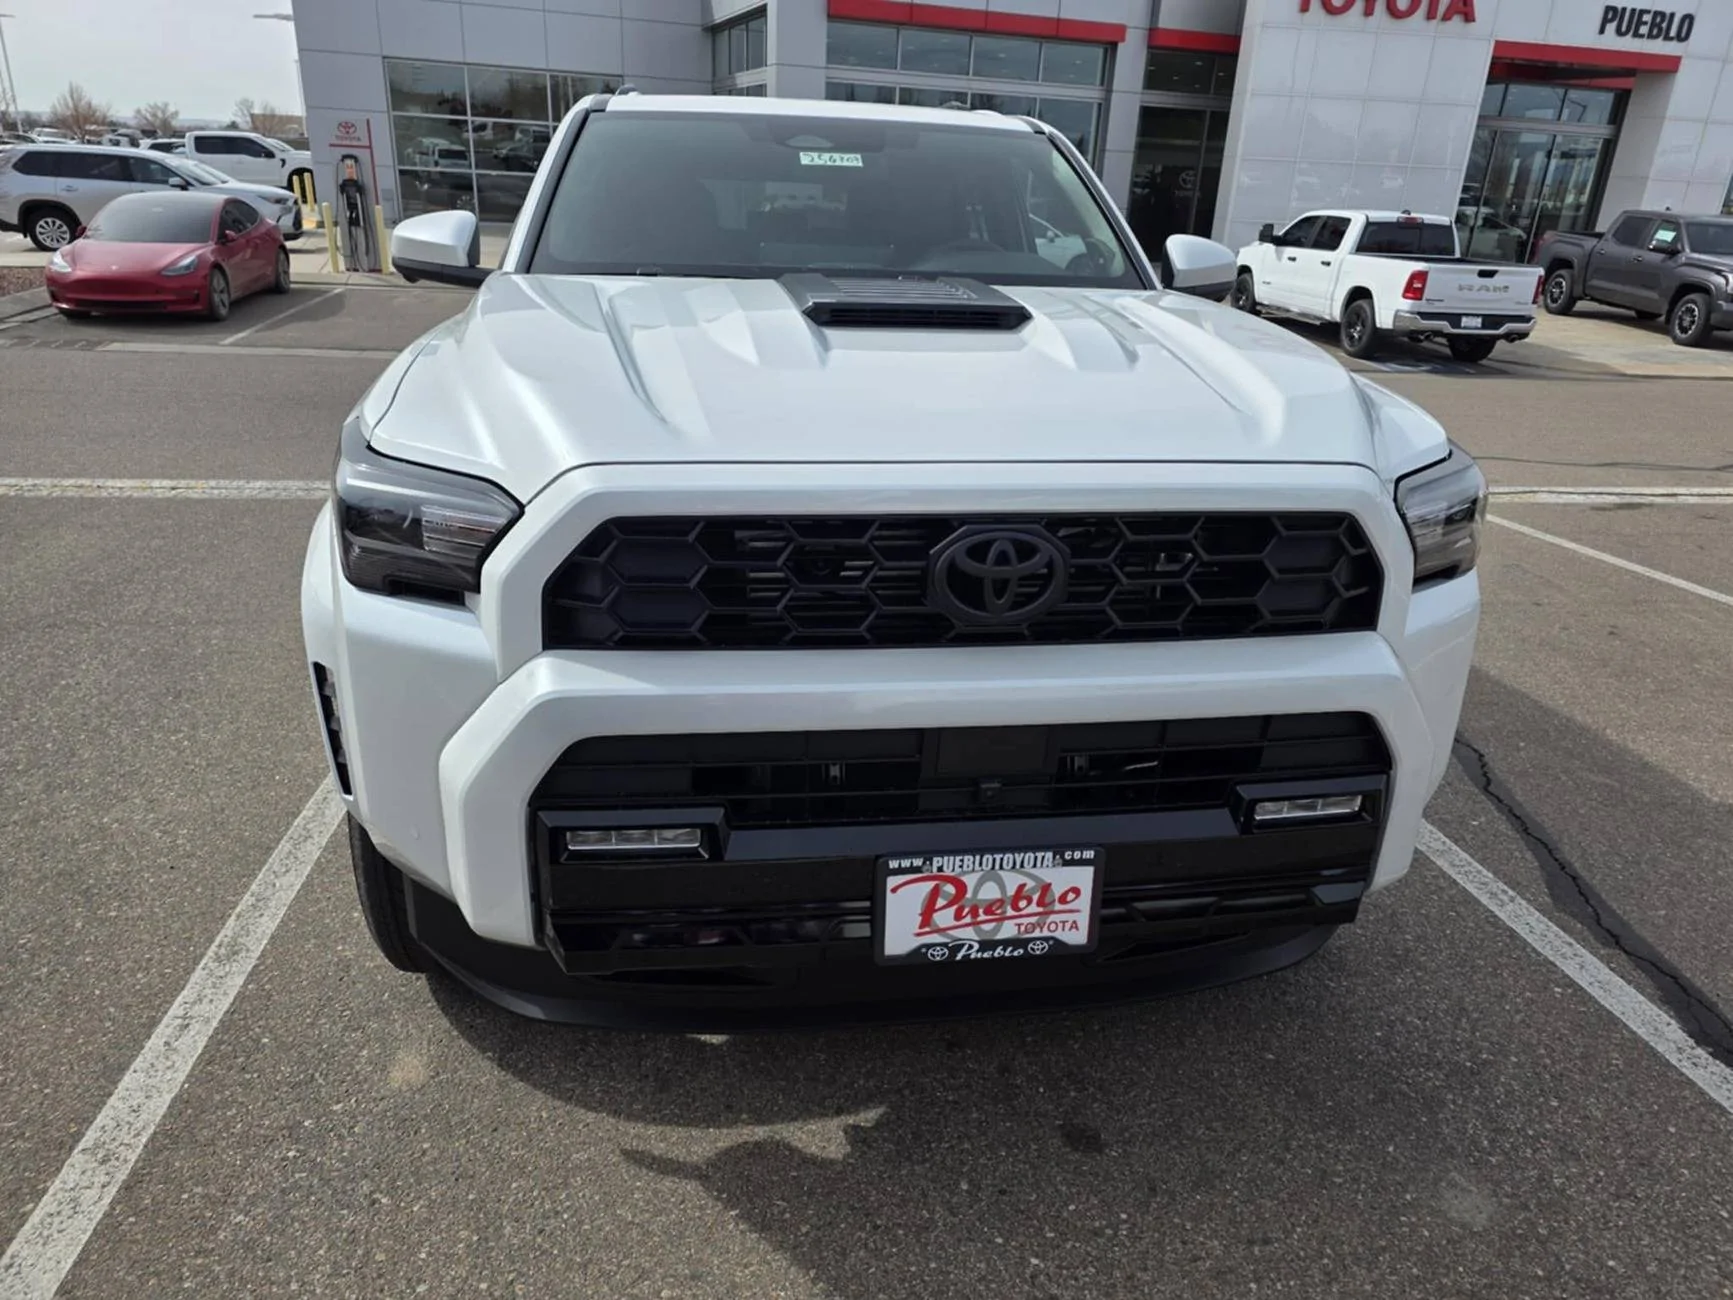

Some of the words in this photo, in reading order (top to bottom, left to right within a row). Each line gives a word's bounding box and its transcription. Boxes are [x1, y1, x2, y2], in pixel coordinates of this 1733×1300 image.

[1598, 4, 1695, 43] PUEBLO
[889, 872, 1082, 931] Pueblo
[1014, 919, 1080, 935] TOYOTA
[948, 940, 1025, 961] Pueblo
